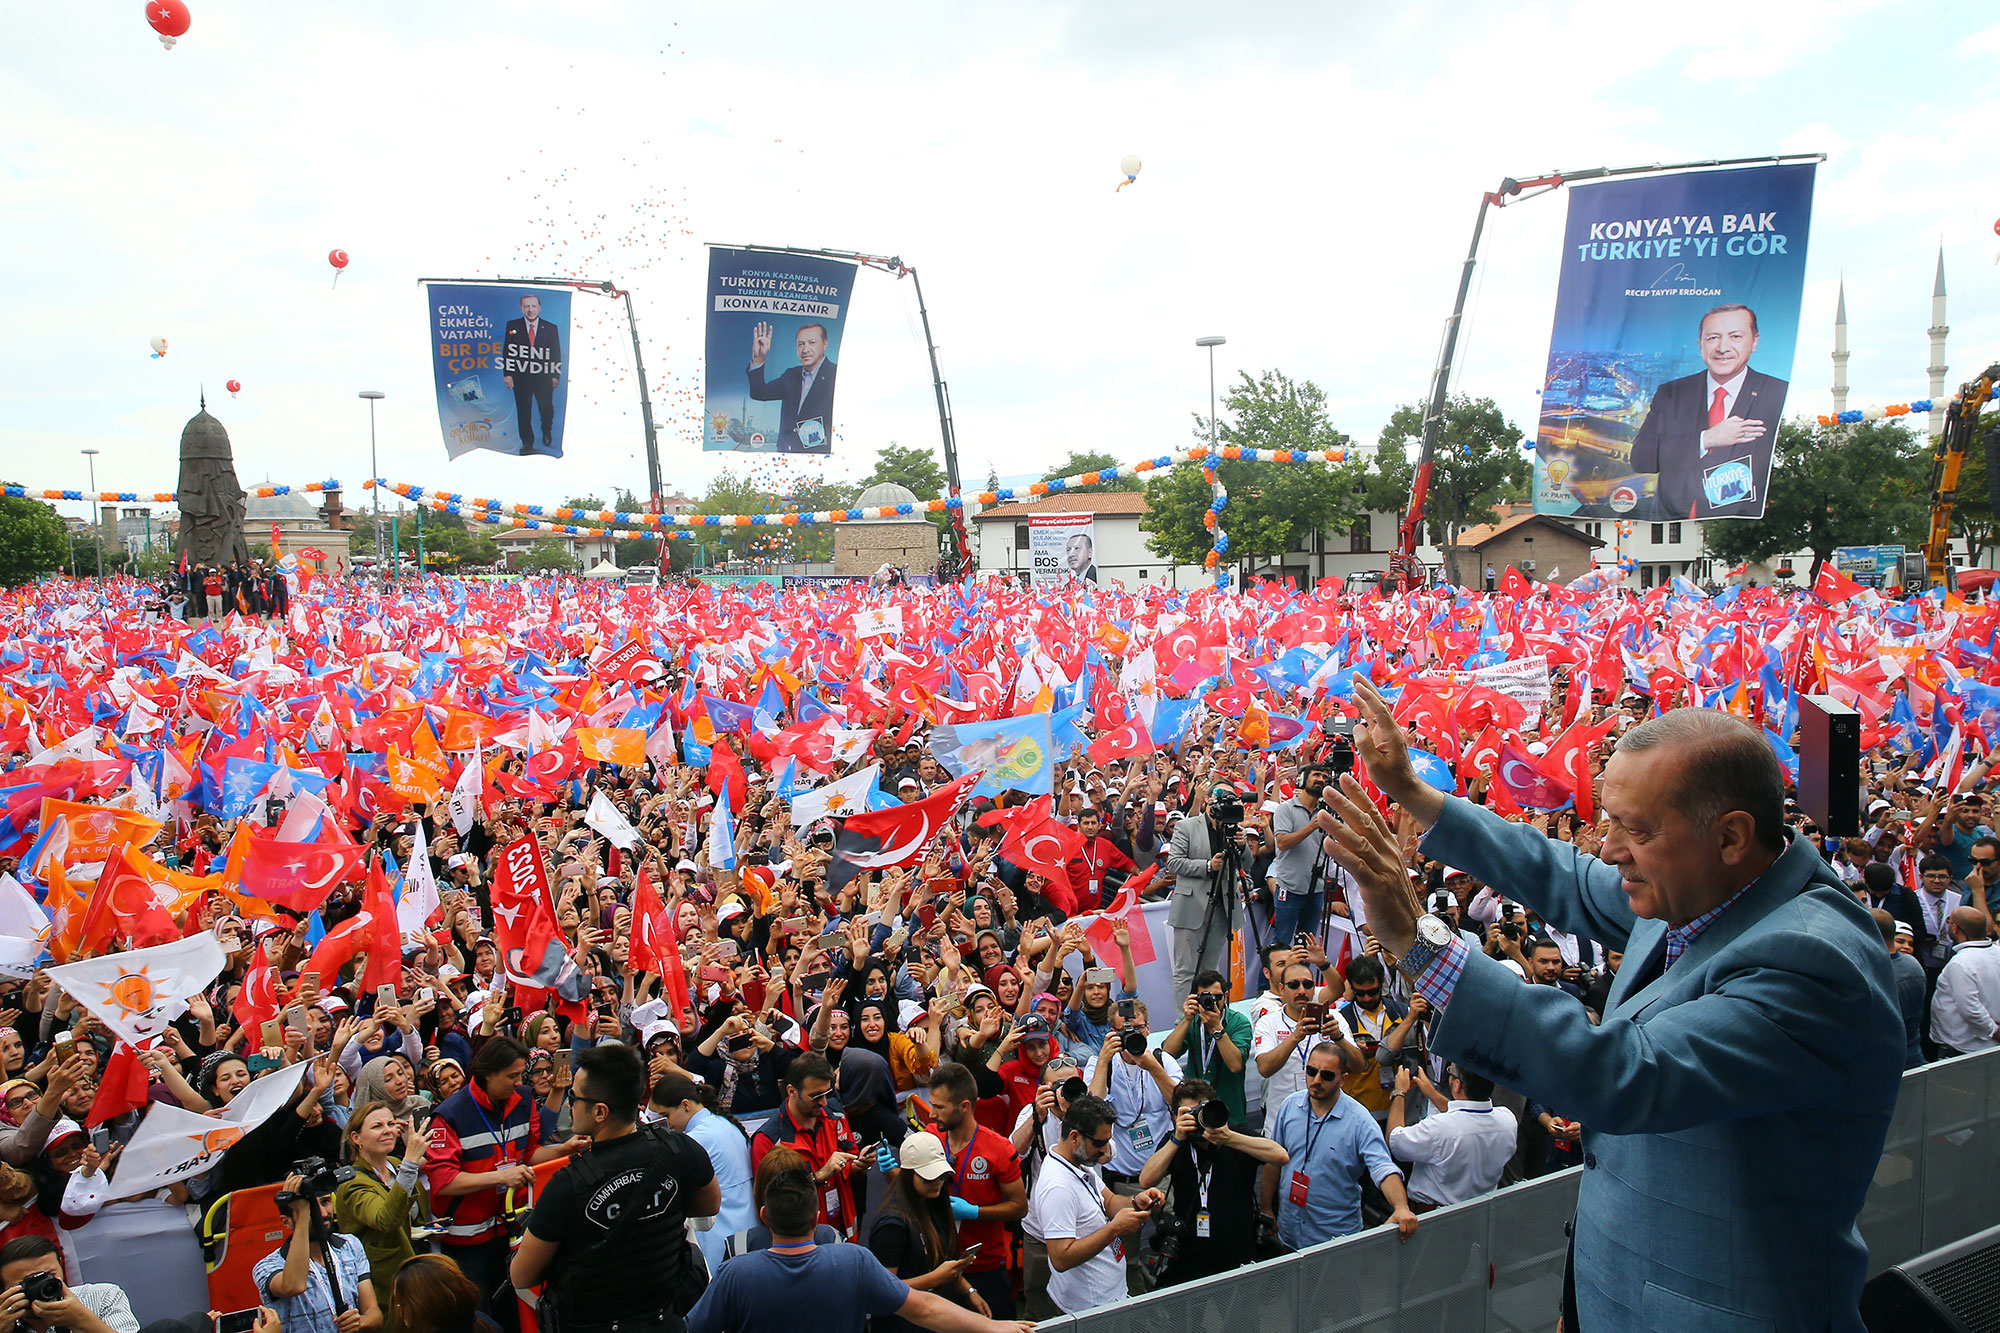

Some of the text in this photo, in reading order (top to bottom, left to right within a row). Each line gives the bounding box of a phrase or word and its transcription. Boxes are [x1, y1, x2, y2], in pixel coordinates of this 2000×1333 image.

[1590, 212, 1776, 240] KONYA'YA BAK
[1726, 234, 1788, 256] GÖR
[742, 270, 819, 283] KONYA KAZANIRSA
[780, 281, 838, 296] KAZANIR
[1679, 287, 1722, 296] ERDOĞAN
[774, 292, 818, 301] KAZANIRSA
[438, 305, 473, 317] ÇAYI,
[724, 299, 829, 314] KONYA KAZANIR
[440, 330, 492, 340] VATANI,
[440, 342, 550, 360] BİR DE SENİ
[448, 357, 562, 374] ÇOK SEVDİK
[415, 756, 427, 766] AK
[394, 783, 422, 794] PARTİ
[222, 881, 239, 892] AK
